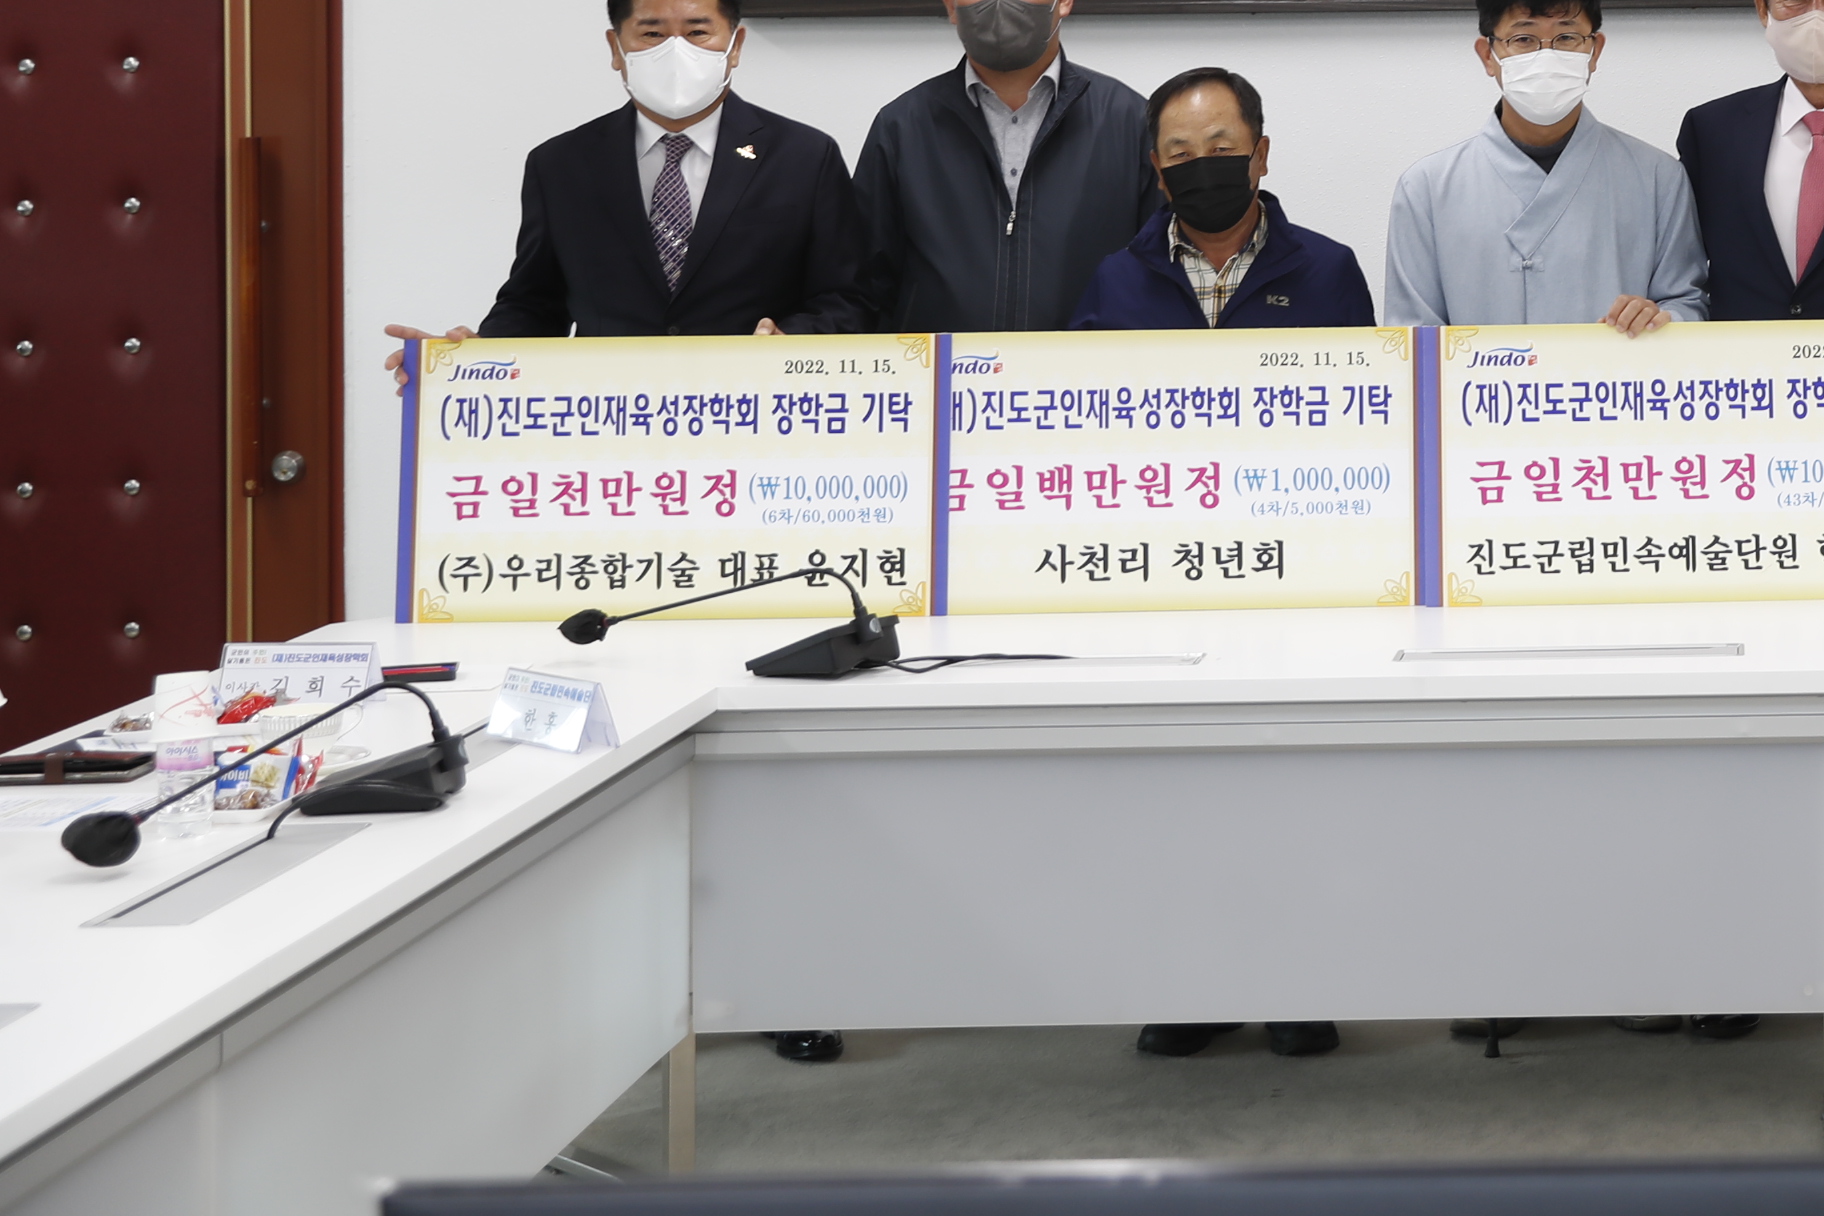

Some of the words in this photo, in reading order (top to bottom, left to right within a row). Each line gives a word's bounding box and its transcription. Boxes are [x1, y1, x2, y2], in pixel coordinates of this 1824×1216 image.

[1264, 294, 1291, 308] K2
[785, 360, 829, 375] 2022.
[840, 360, 862, 375] 11.
[874, 360, 895, 374] 15.
[1260, 353, 1303, 367] 2022.
[1315, 352, 1336, 367] 11.
[1348, 352, 1369, 366] 15.
[441, 393, 758, 440] (재)진도군인재육성장학회
[772, 392, 849, 435] 장학금
[862, 393, 912, 432] 기탁
[1253, 385, 1329, 427] 장학금
[1343, 385, 1392, 425] 기탁
[1462, 378, 1773, 426] (재)진도군인재육성장학회
[446, 469, 736, 520] 금일천만원정
[1470, 453, 1755, 505] 금일천만원정
[762, 507, 893, 524] (6차/60,000천원)
[1251, 499, 1371, 516] (4차/5,000천원)
[439, 552, 700, 593] (주)우리종합기술
[718, 551, 781, 588] 대표
[803, 548, 906, 589] 윤지현
[1035, 543, 1149, 583] 사천리
[1172, 540, 1283, 580] 청년회
[1467, 533, 1799, 575] 진도군립민속예술단원
